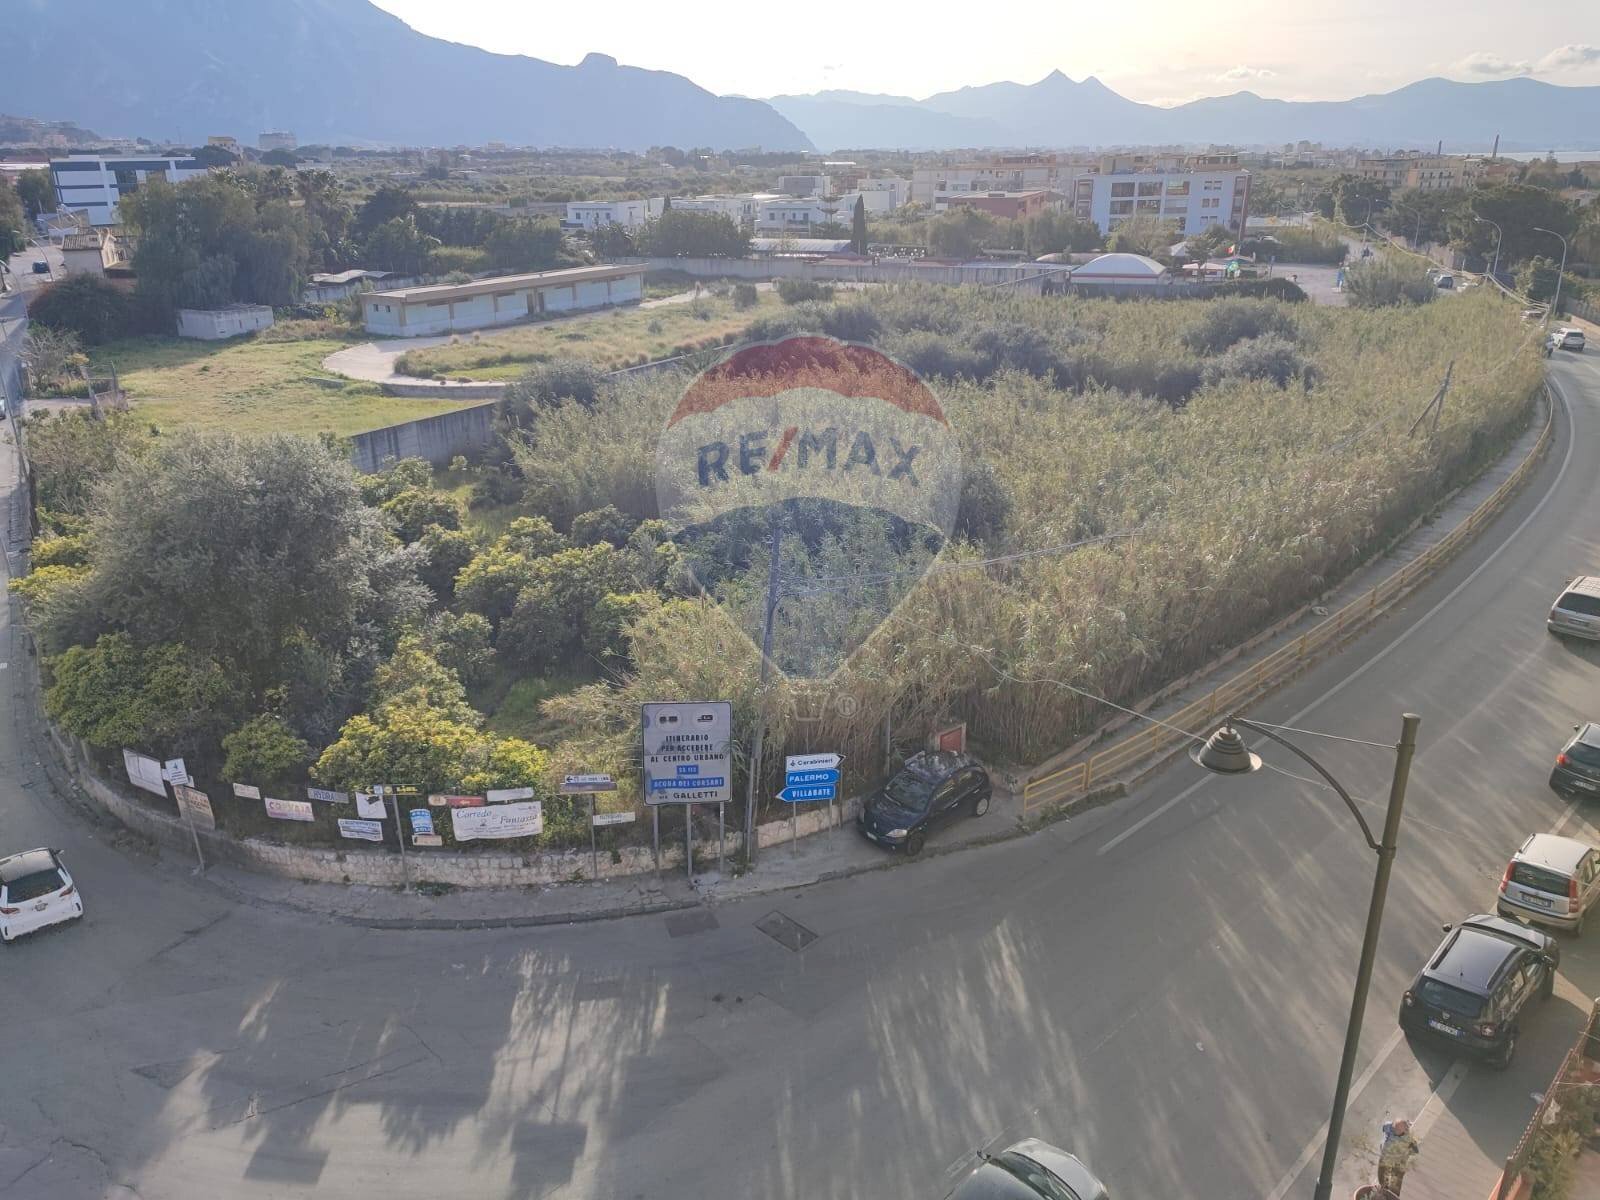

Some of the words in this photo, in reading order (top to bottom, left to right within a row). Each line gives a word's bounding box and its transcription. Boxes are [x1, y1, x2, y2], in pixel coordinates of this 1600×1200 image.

[665, 734, 709, 743] ITINERARIO
[661, 745, 675, 753] PER
[677, 743, 714, 752] ACCEDERE
[663, 755, 691, 763] CENTRO
[693, 753, 725, 761] URBANO
[797, 758, 833, 767] Carabinieri
[789, 773, 829, 783] PALERMO
[653, 780, 677, 789] ACQUA
[678, 779, 691, 788] DEI
[692, 778, 723, 787] CORSARI
[673, 790, 718, 800] GALLETTI
[792, 788, 831, 798] VILLABATE
